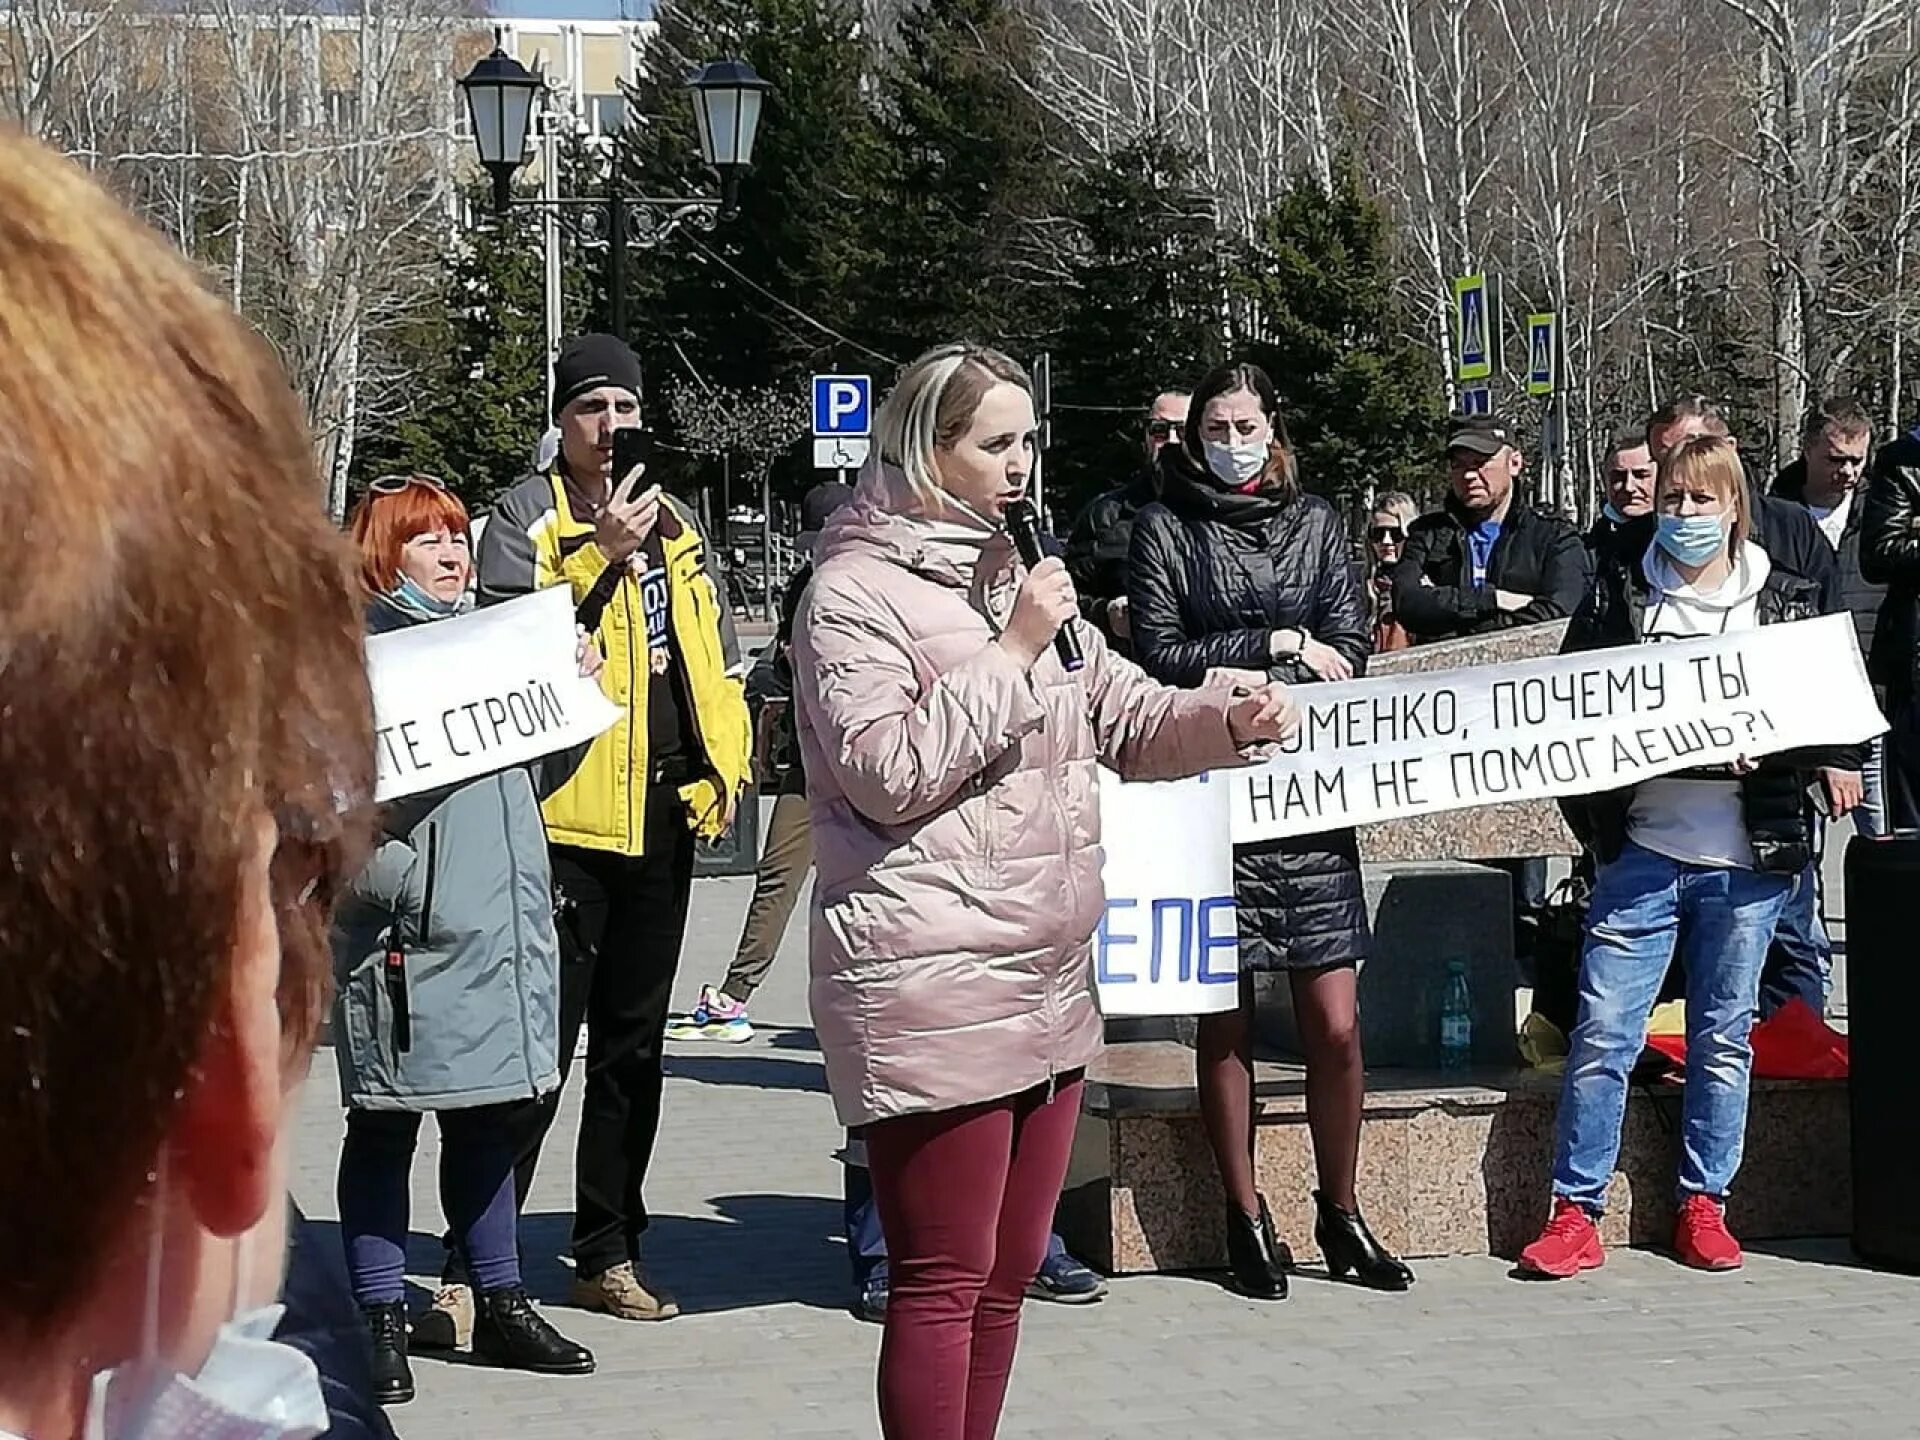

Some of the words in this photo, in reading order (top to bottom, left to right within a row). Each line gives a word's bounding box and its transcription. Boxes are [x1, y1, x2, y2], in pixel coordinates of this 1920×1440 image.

[829, 382, 861, 429] P
[376, 719, 433, 781] ТЕ
[441, 679, 570, 757] СТРОЙ!
[1492, 662, 1665, 729] ПОЧЕМУ
[1688, 651, 1750, 704] ТЫ
[1248, 765, 1348, 823] НАМ
[1371, 757, 1428, 809] НЕ
[1449, 709, 1777, 799] ПОМОГАЕШЬ?!
